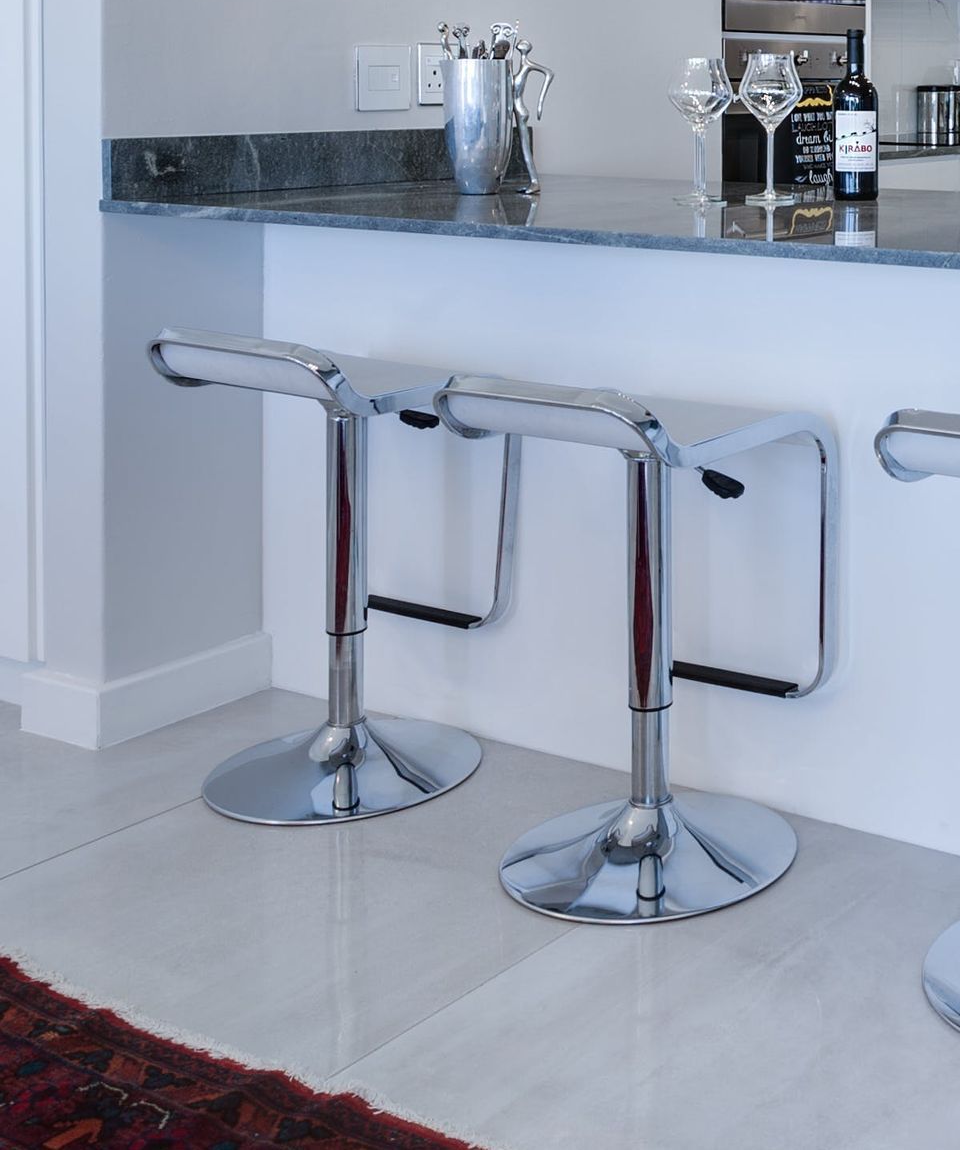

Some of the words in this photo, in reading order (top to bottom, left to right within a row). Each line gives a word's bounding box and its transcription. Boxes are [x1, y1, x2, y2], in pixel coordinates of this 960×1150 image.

[796, 131, 821, 145] dream
[839, 144, 873, 154] KIRABO
[809, 168, 833, 186] laugh
